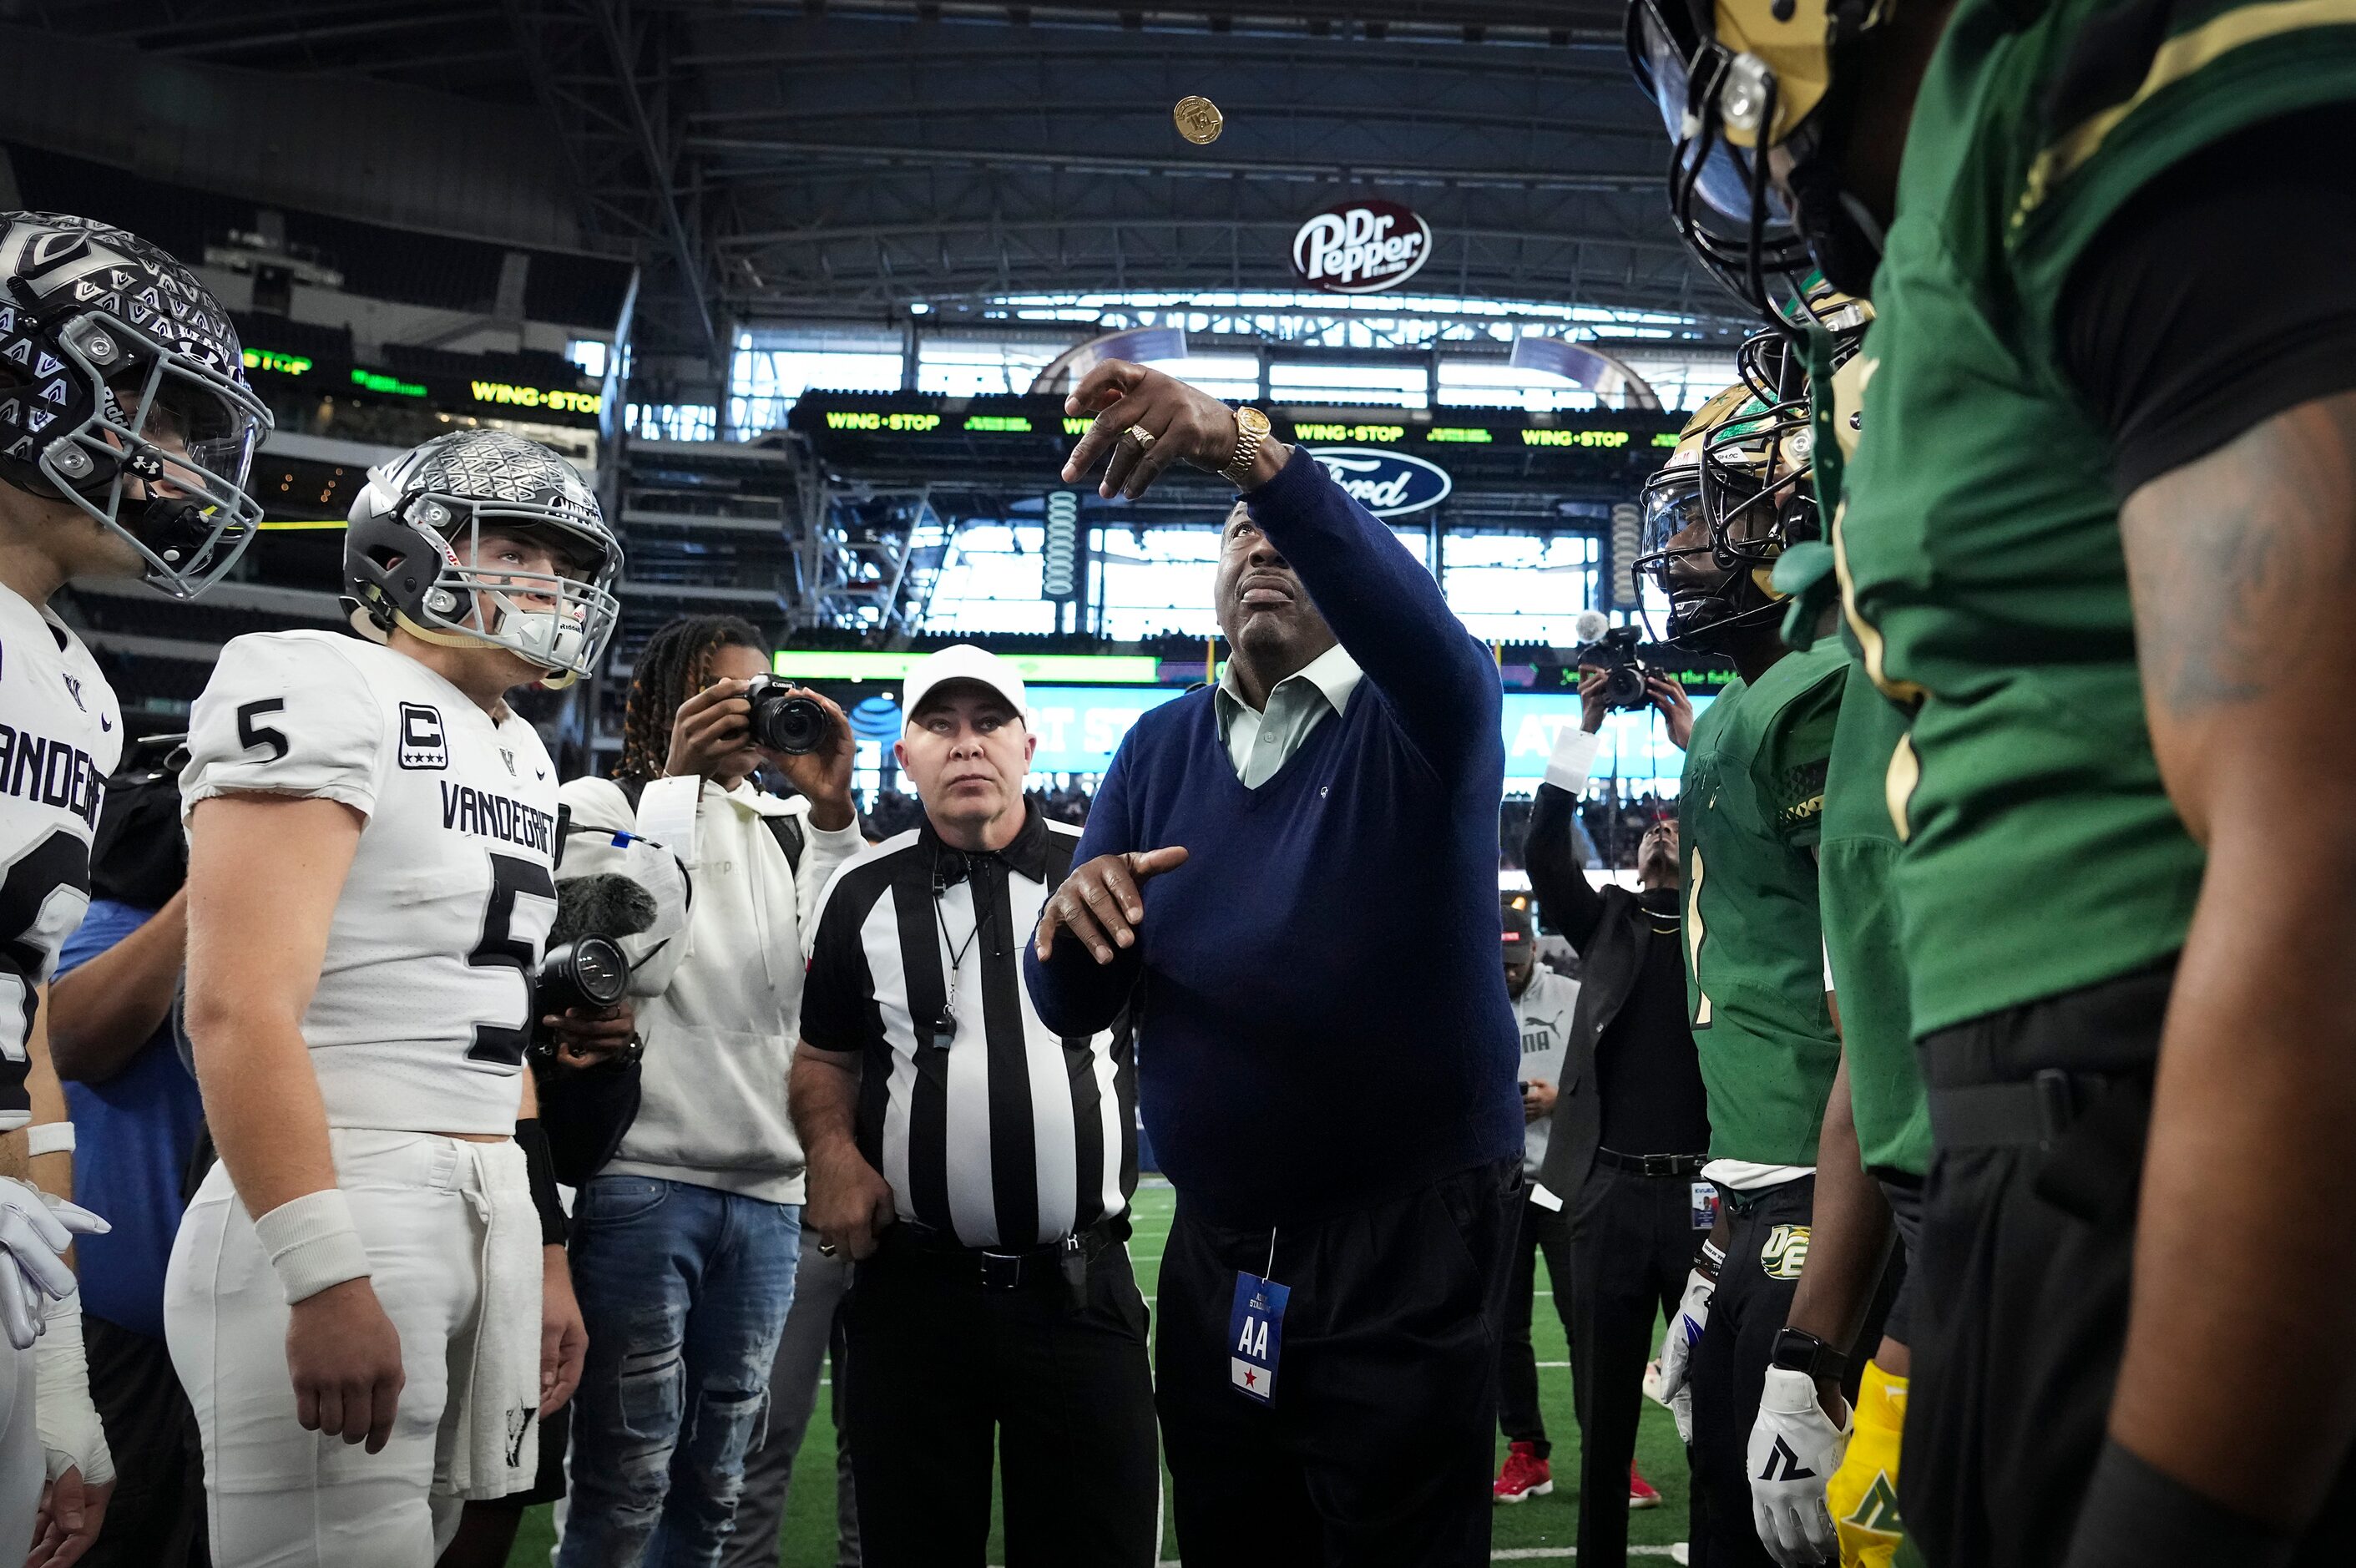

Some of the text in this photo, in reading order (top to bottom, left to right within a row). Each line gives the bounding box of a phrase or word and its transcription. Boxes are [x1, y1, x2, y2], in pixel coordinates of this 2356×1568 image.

[1293, 214, 1423, 283] Pepper
[1345, 209, 1394, 247] Dr
[238, 698, 289, 766] 5
[405, 708, 441, 747] C
[440, 780, 554, 858] VANDEGRIFT
[467, 851, 558, 1066] 5
[1237, 1316, 1268, 1361] AA
